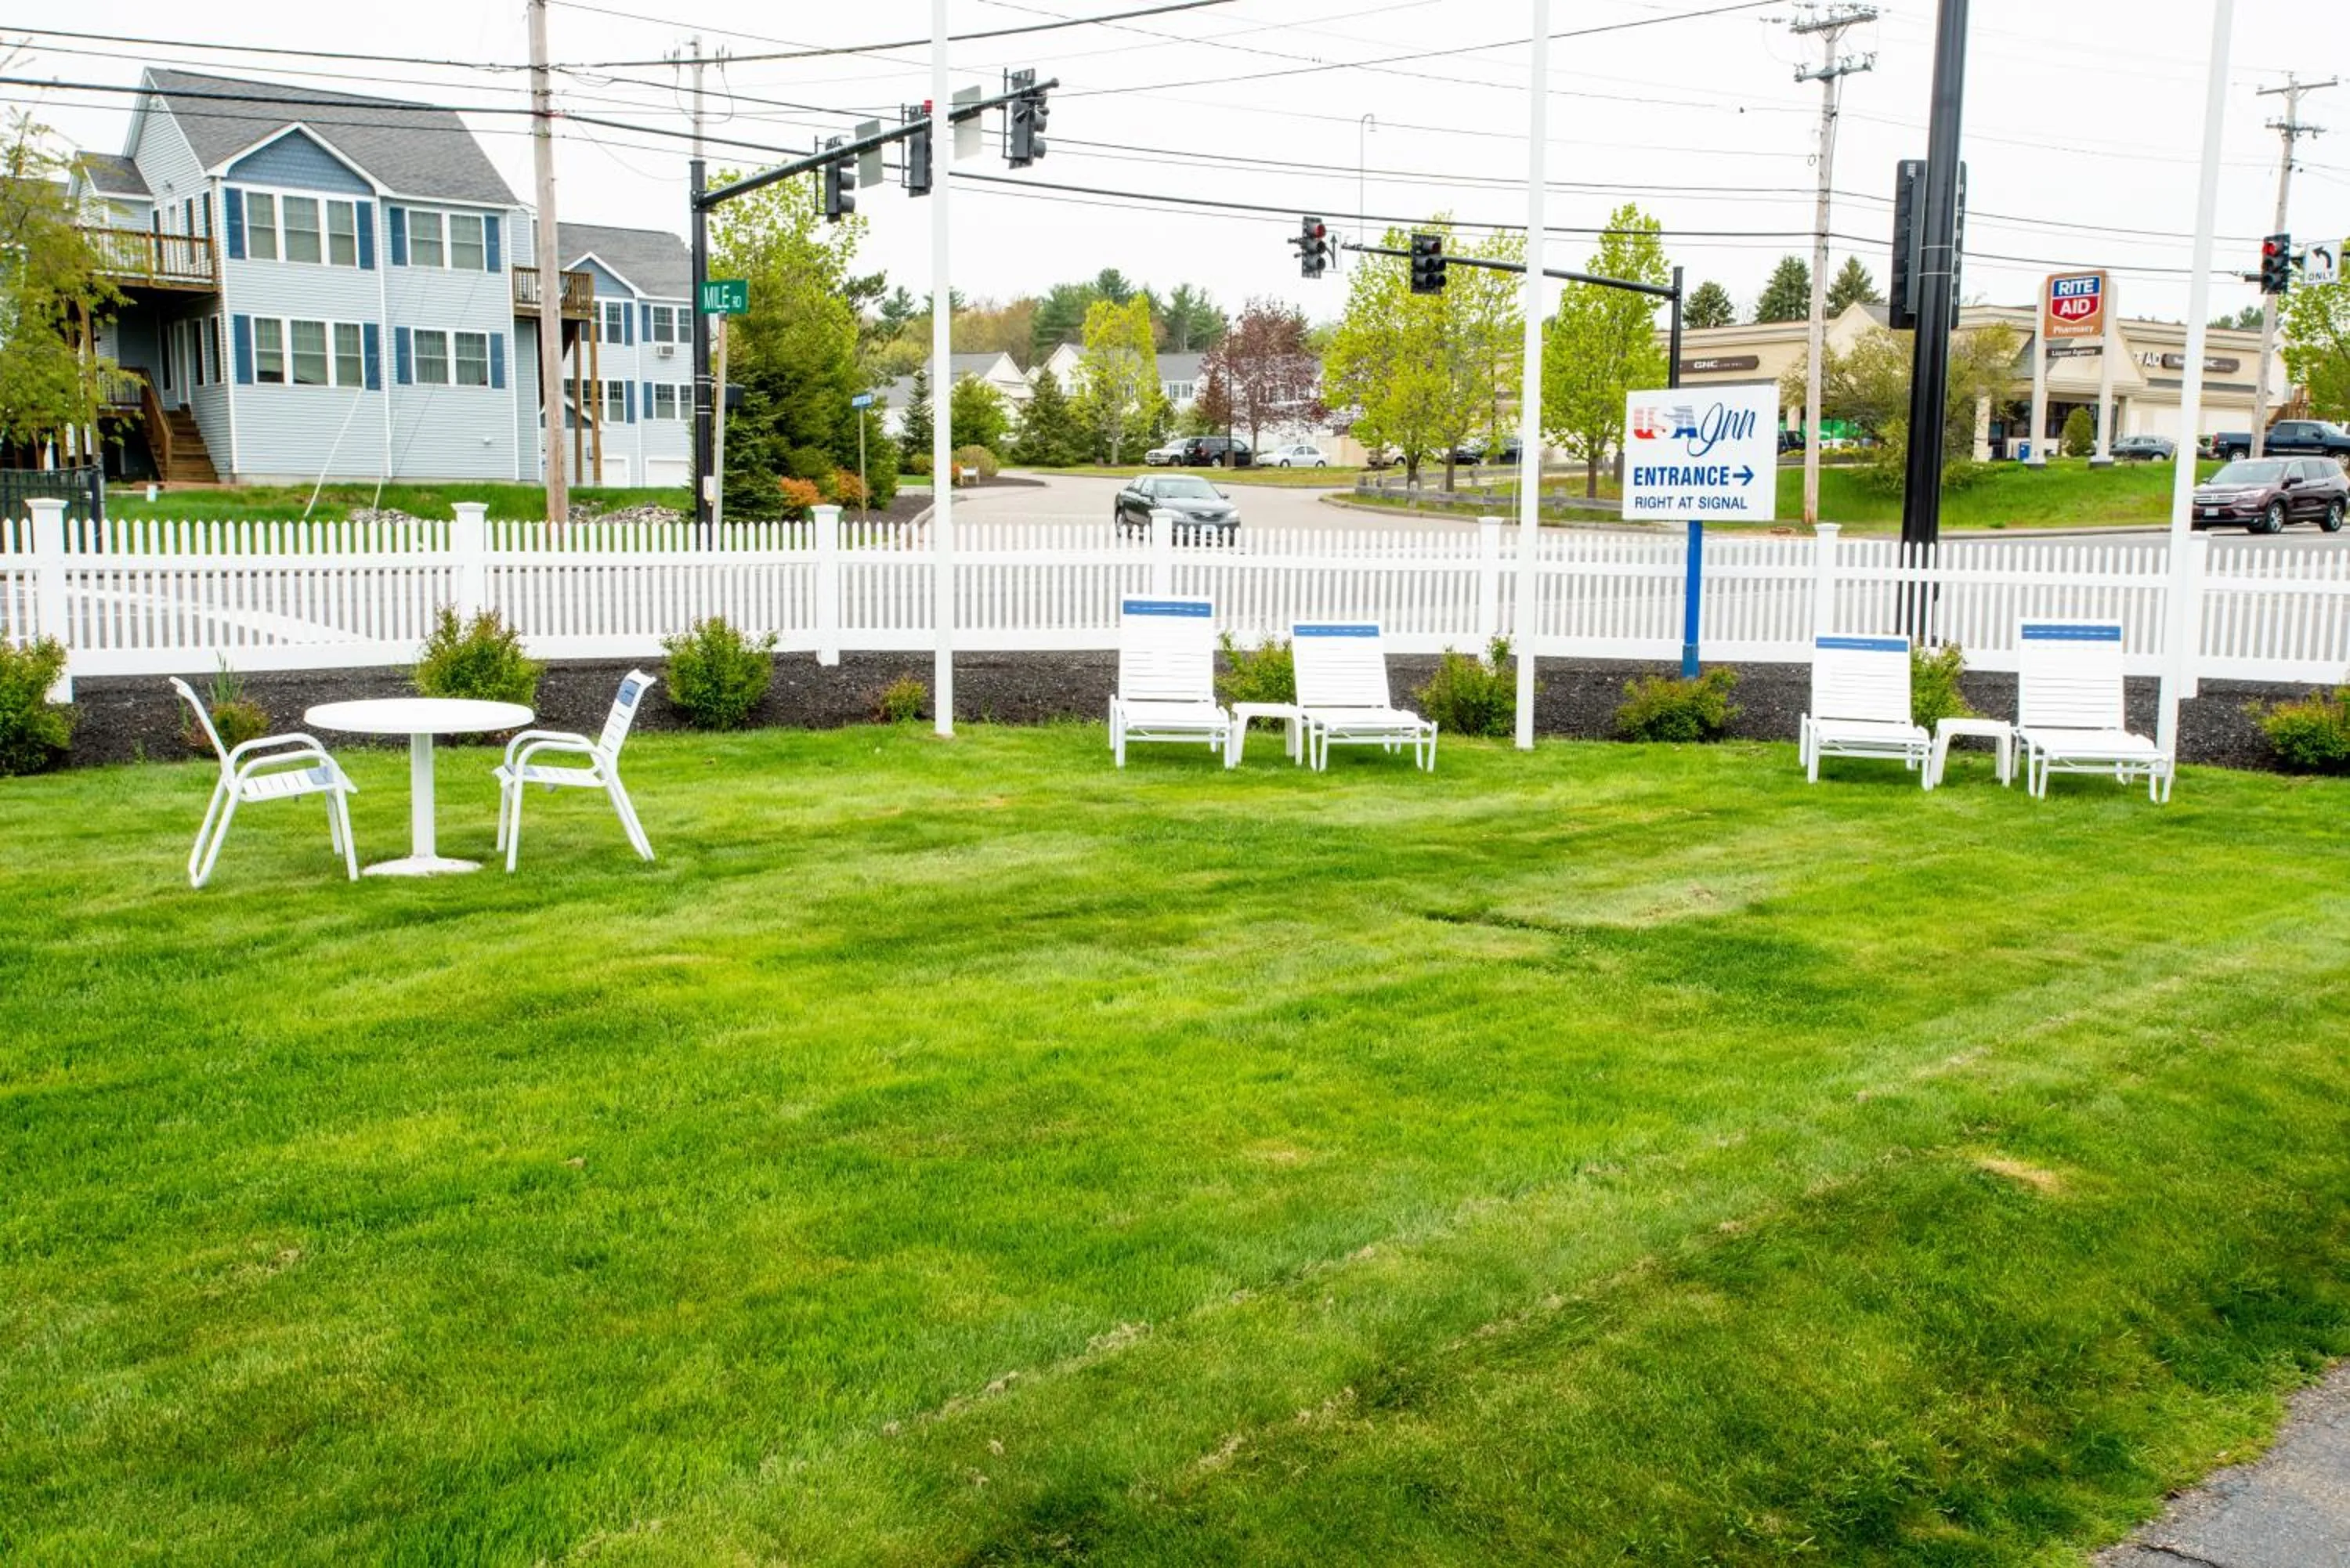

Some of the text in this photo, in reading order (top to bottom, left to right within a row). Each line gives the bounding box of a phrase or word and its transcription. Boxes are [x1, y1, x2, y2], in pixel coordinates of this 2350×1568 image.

[2058, 279, 2094, 294] RITE
[704, 285, 730, 309] MILE
[2059, 299, 2091, 315] AID
[1693, 359, 1719, 370] GNC
[1633, 466, 1730, 486] ENTRANCE
[1635, 496, 1748, 510] RIGHT AT SIGNAL
